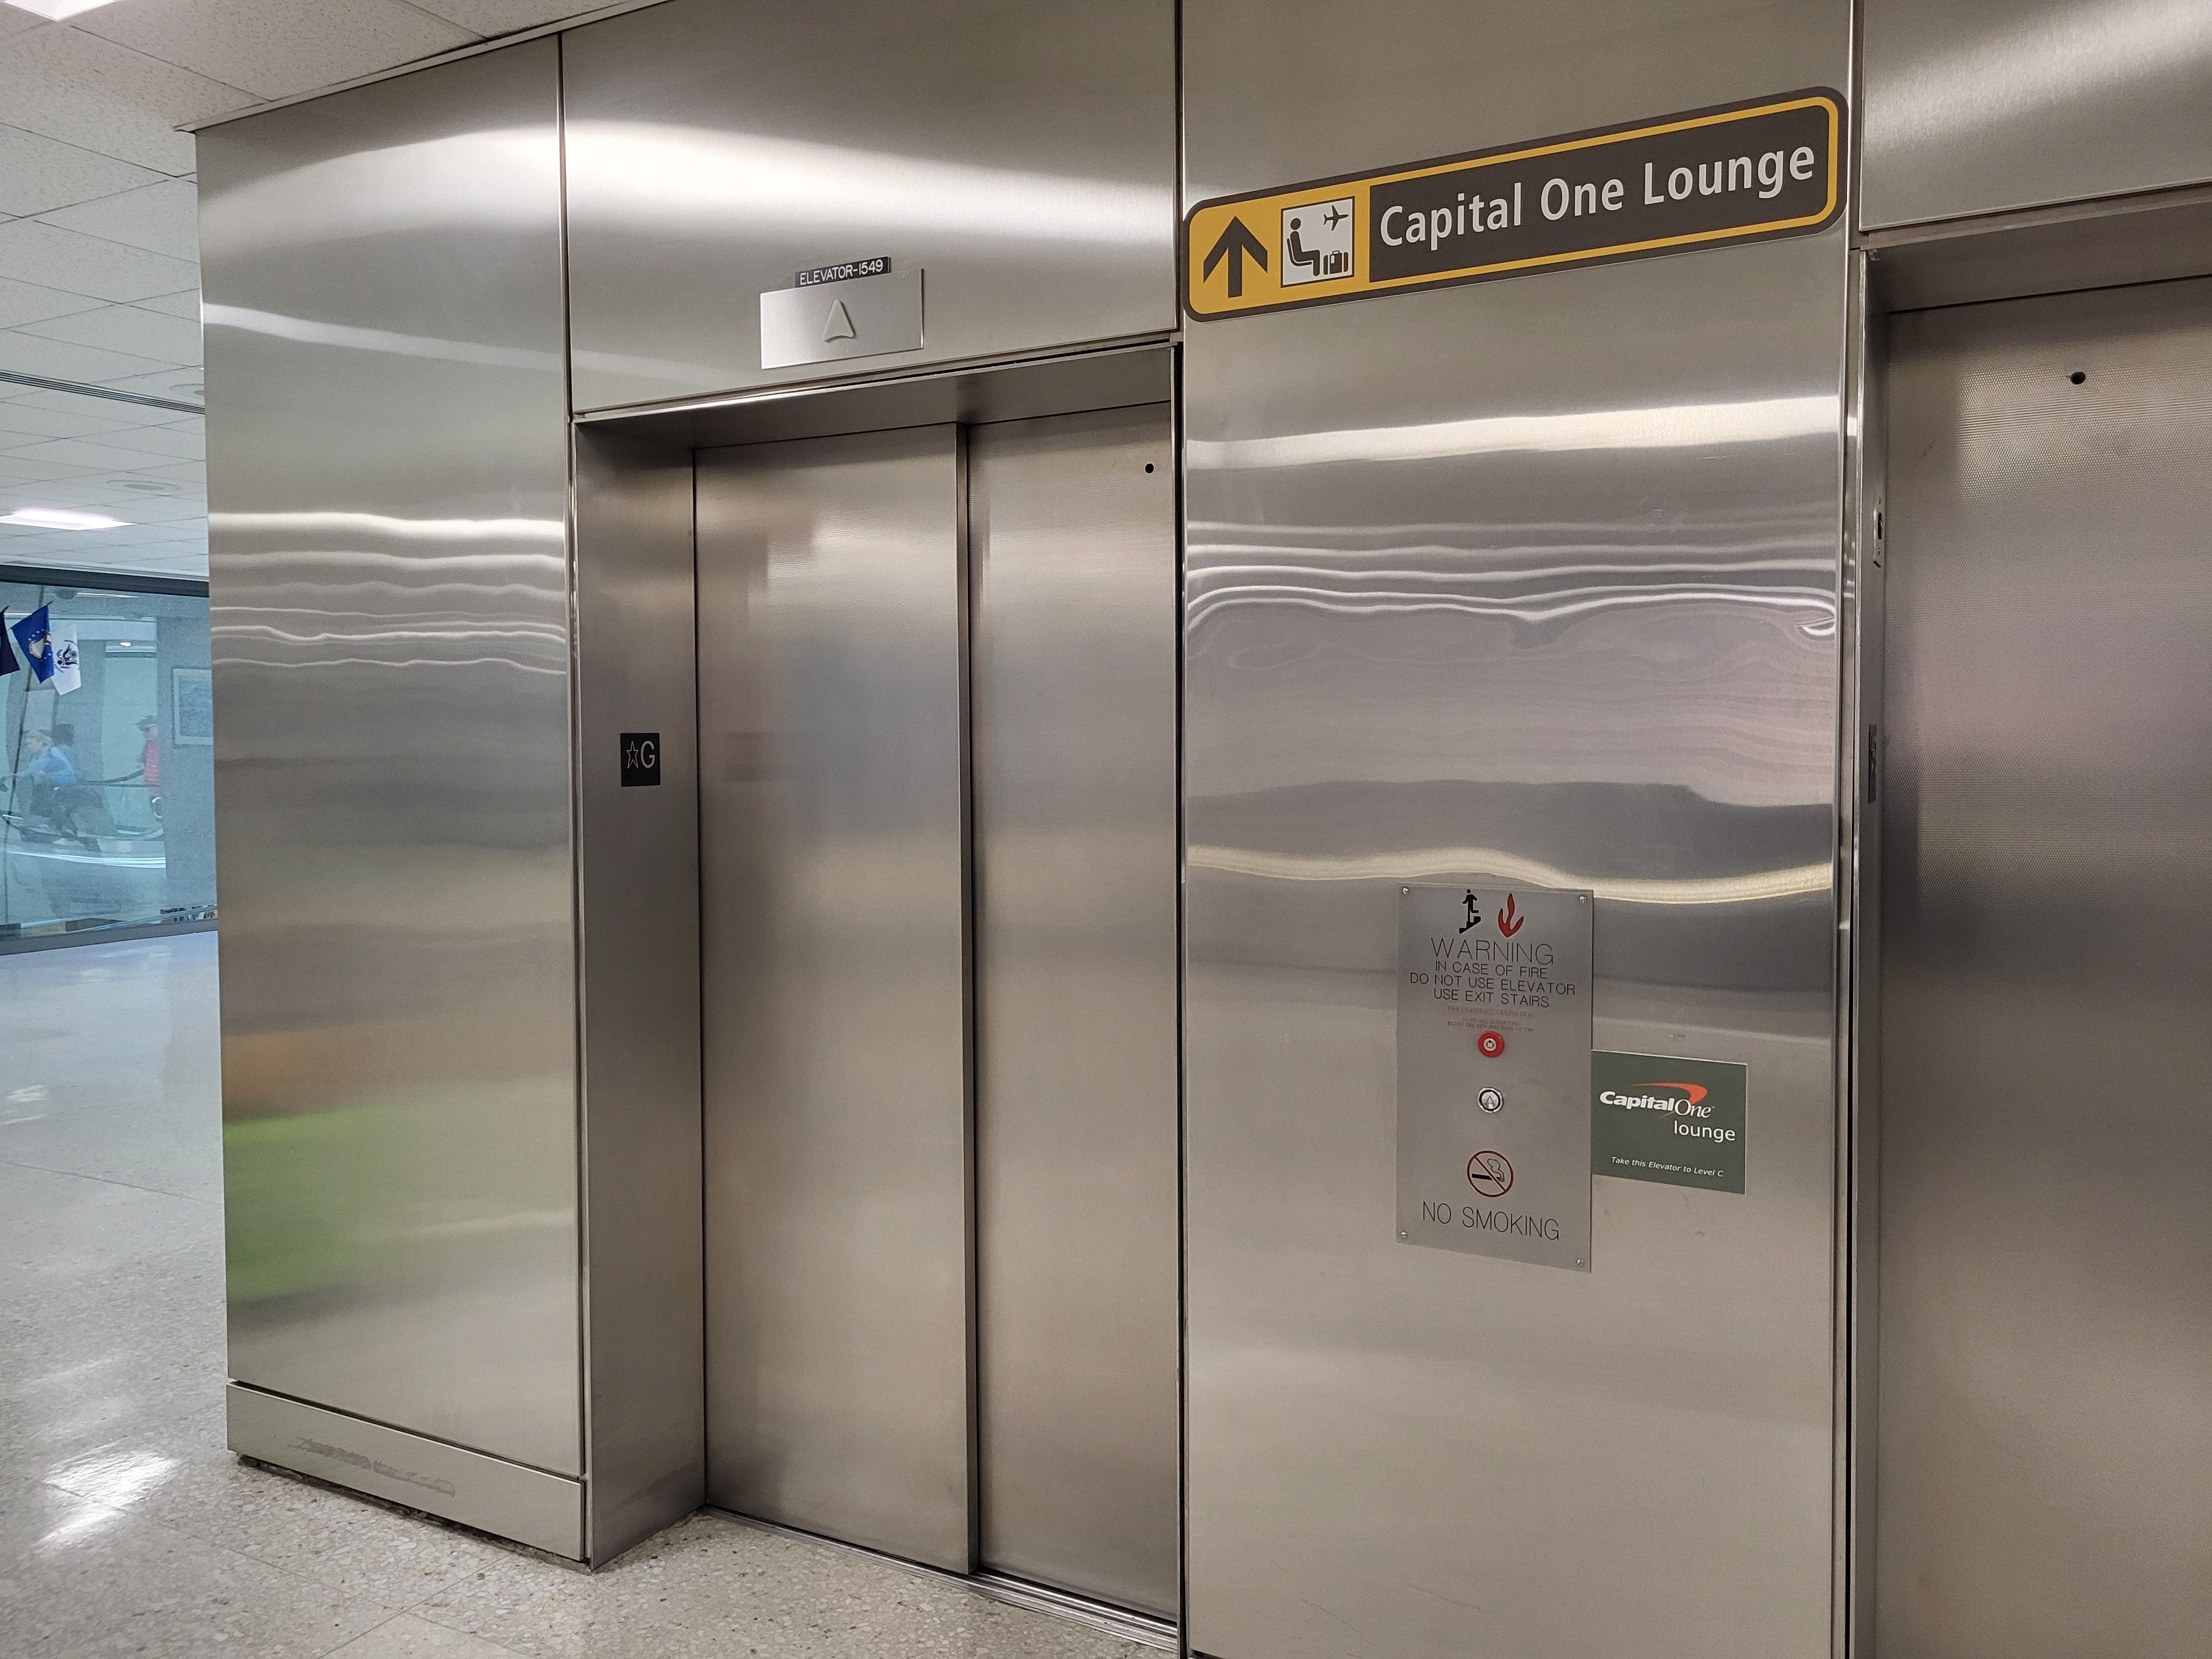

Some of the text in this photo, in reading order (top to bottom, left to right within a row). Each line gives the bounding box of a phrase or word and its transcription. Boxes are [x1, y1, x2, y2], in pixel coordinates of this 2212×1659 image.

[1380, 146, 1814, 251] Capital One Lounge
[1431, 937, 1553, 965] WARNING
[1435, 961, 1548, 979] IN CASE OF FIRE
[1410, 972, 1575, 995] DO NOT USE ELEVATOR
[1433, 988, 1550, 1008] USE EXIT STAIRS
[1673, 1120, 1736, 1143] lounge
[1611, 1156, 1630, 1165] Take
[1631, 1159, 1646, 1167] this
[1648, 1161, 1682, 1172] Elevator
[1693, 1167, 1715, 1176] Level
[1423, 1201, 1559, 1240] NO SMOKING
